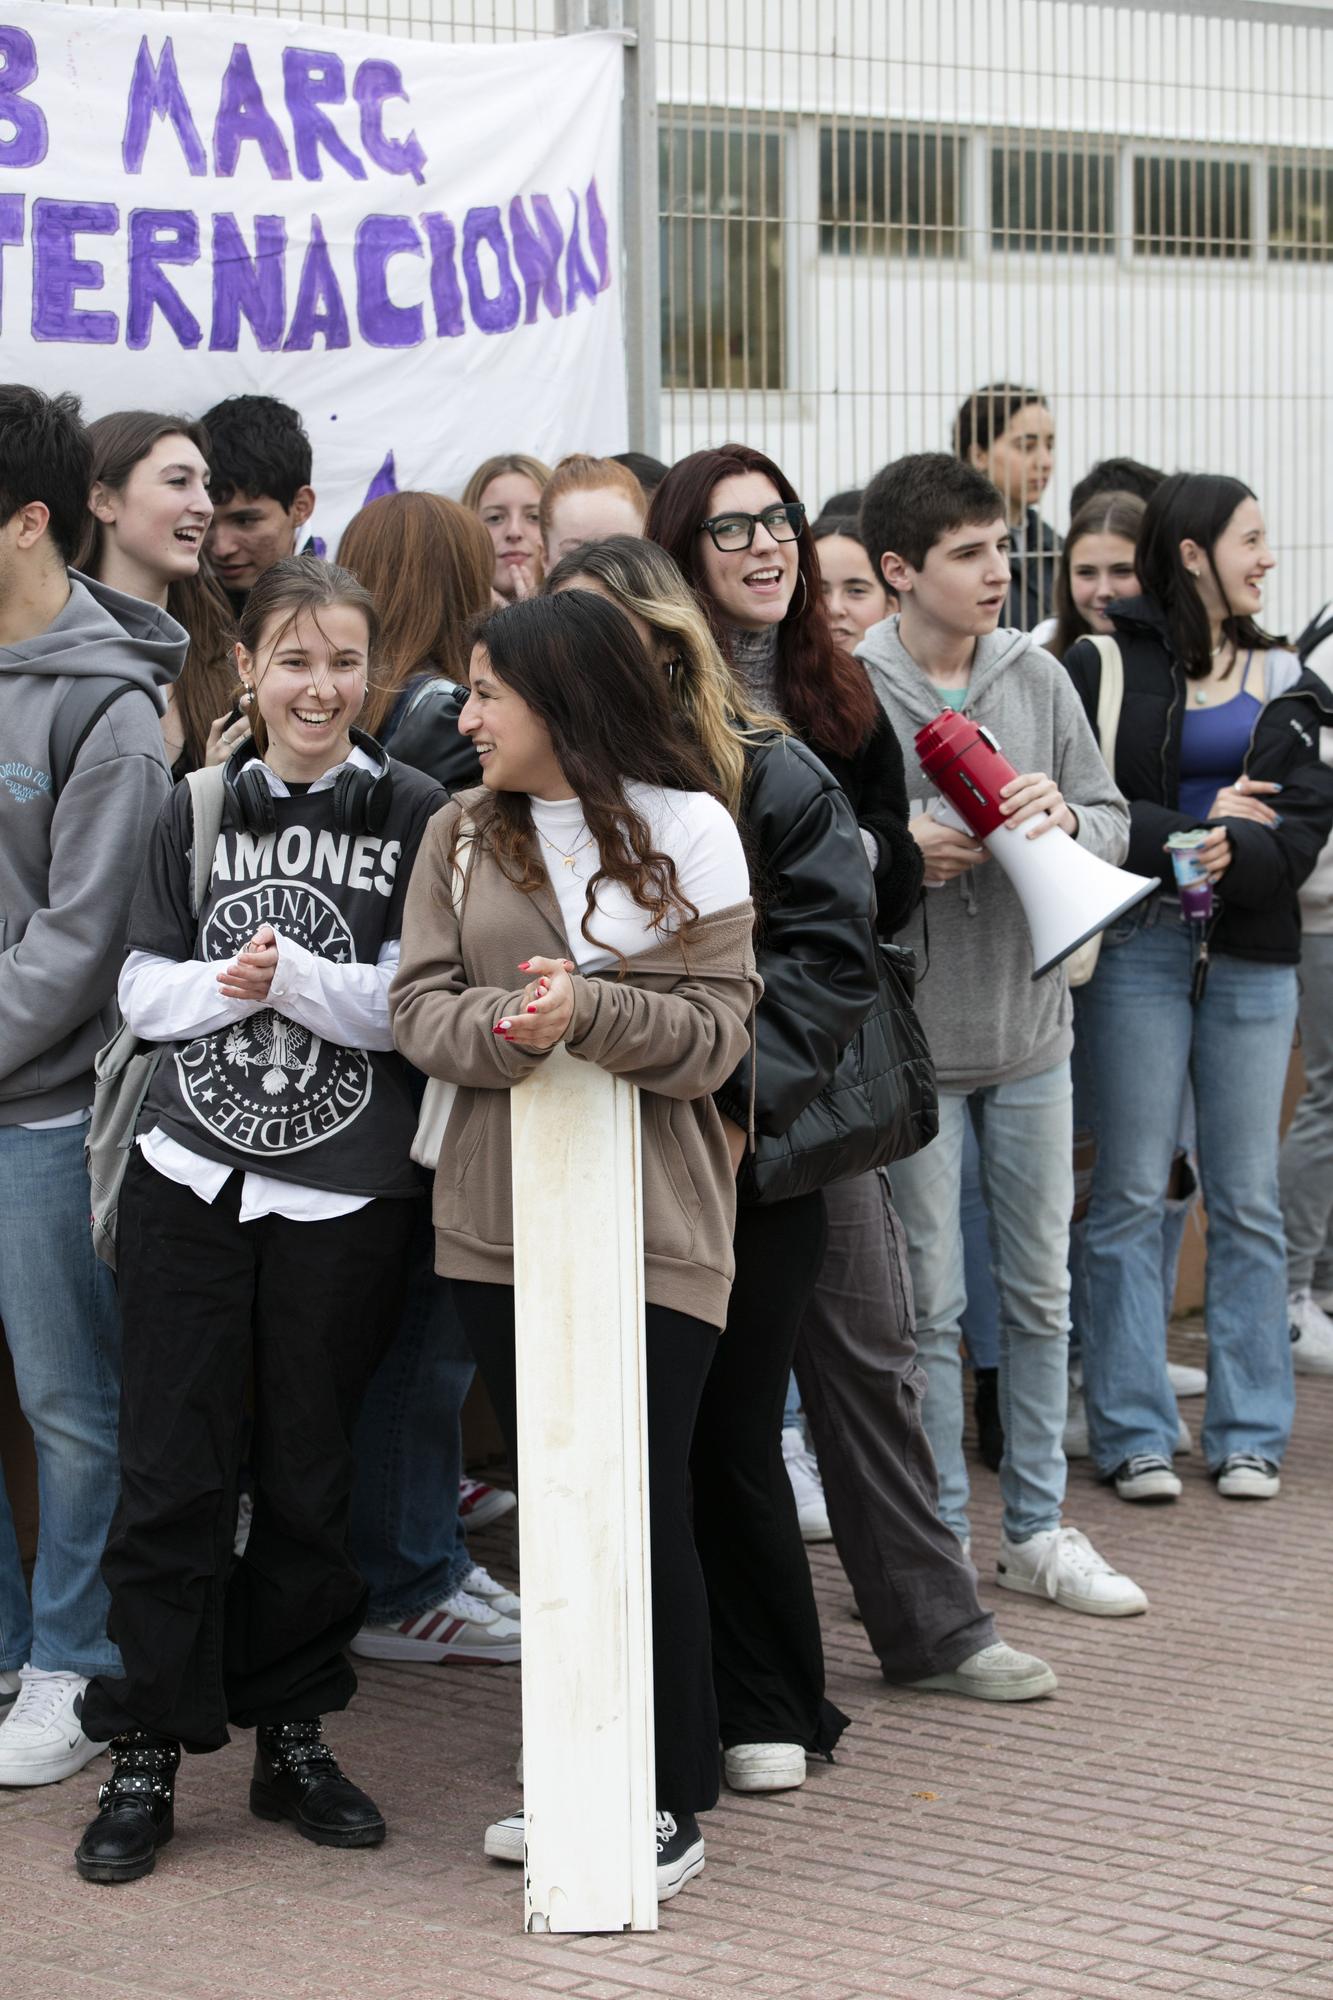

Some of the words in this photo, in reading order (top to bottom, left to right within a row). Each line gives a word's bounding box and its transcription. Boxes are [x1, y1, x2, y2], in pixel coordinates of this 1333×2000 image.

[209, 825, 402, 898] AMONES
[211, 887, 350, 954] JOHNNY
[208, 1075, 364, 1149] DEEDEE
